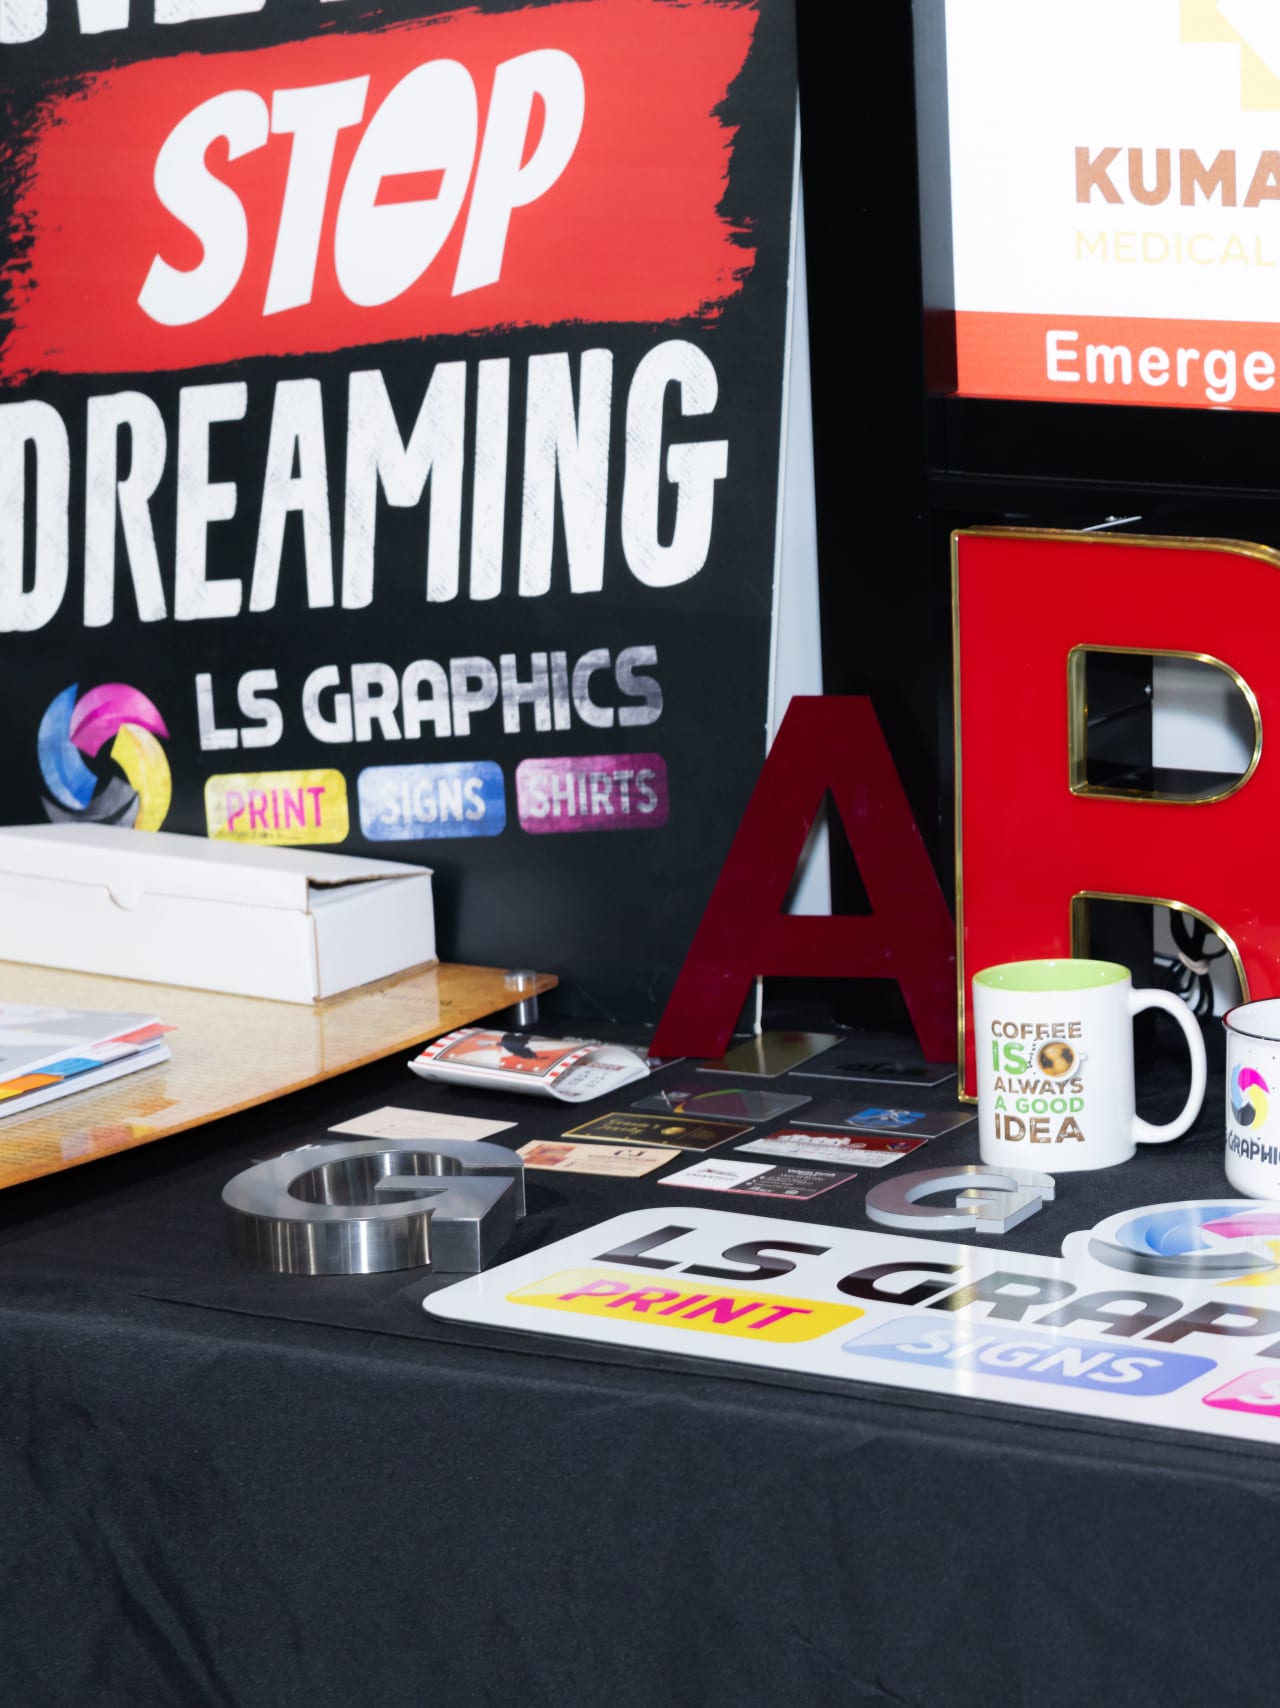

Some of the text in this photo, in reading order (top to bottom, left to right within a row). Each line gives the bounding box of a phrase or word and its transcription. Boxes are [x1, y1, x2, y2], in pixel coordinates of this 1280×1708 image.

[137, 48, 585, 326] STOP
[1075, 230, 1276, 268] MEDICAL
[0, 339, 729, 633] DREAMING
[195, 645, 664, 751] LS GRAPHICS
[225, 786, 326, 832] PRINT
[377, 776, 486, 825] SIGNS
[529, 769, 659, 819] SHIRTS
[991, 1020, 1083, 1041] COFFEE
[991, 1040, 1028, 1075] IS
[994, 1076, 1084, 1095] ALWAYS
[994, 1095, 1085, 1114] A GOOD
[994, 1112, 1085, 1144] IDEA
[592, 1225, 832, 1281] LS
[558, 1278, 812, 1330] PRINT
[895, 1327, 1167, 1384] SIGNS
